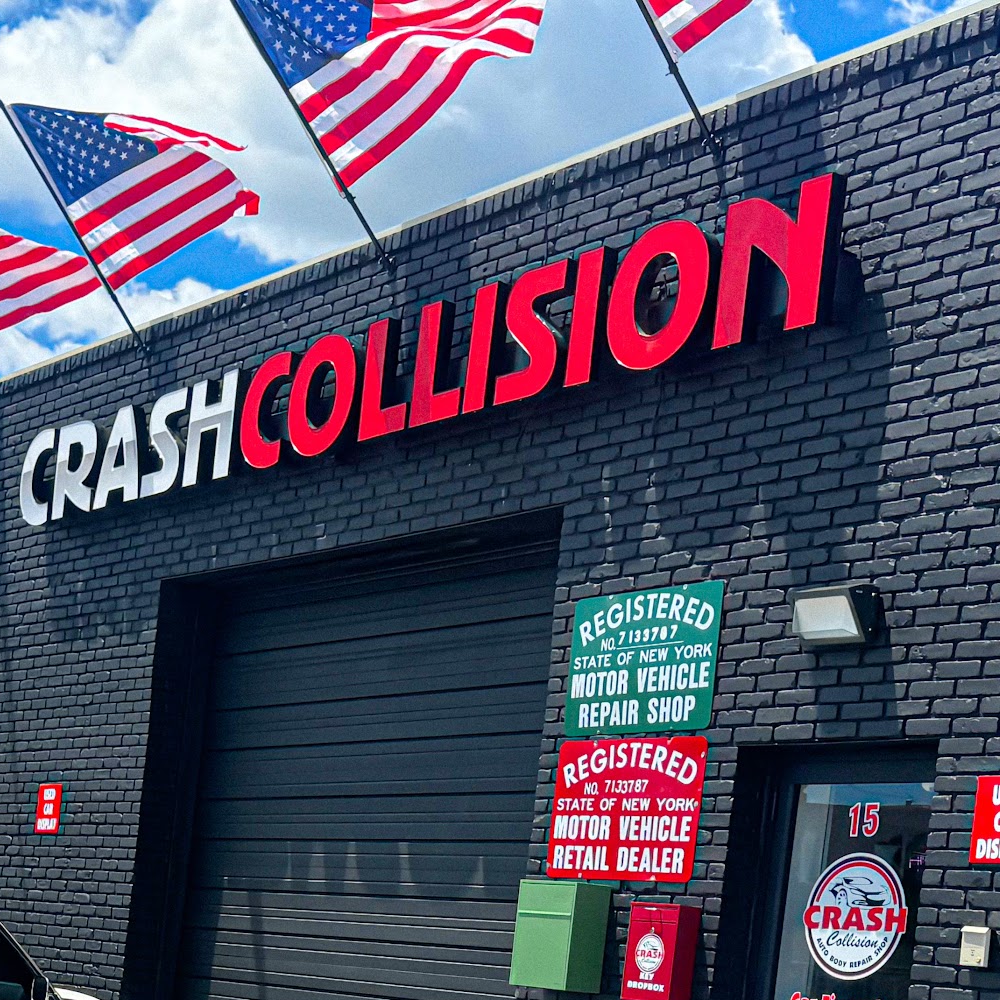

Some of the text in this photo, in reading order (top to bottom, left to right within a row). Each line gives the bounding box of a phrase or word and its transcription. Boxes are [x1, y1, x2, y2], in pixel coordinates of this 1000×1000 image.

[579, 592, 715, 647] REGISTERED
[574, 642, 713, 670] STATE OF NEW YORK
[601, 637, 616, 652] NO.
[571, 661, 711, 699] MOTOR VEHICLE
[578, 695, 697, 728] REPAIR SHOP
[563, 742, 698, 788] REGISTERED
[584, 779, 650, 795] NO. 7133787
[557, 798, 695, 812] STATE OF NEW YORK
[553, 815, 692, 842] MOTOR VEHICLE
[849, 802, 880, 837] 15
[553, 845, 685, 874] RETAIL DEALER
[803, 905, 908, 934] CRASH
[817, 936, 888, 968] AUTO BODY REPAIR SHOP
[826, 931, 879, 948] Collision
[636, 949, 664, 959] CRASH
[627, 980, 664, 992] DROPBOX
